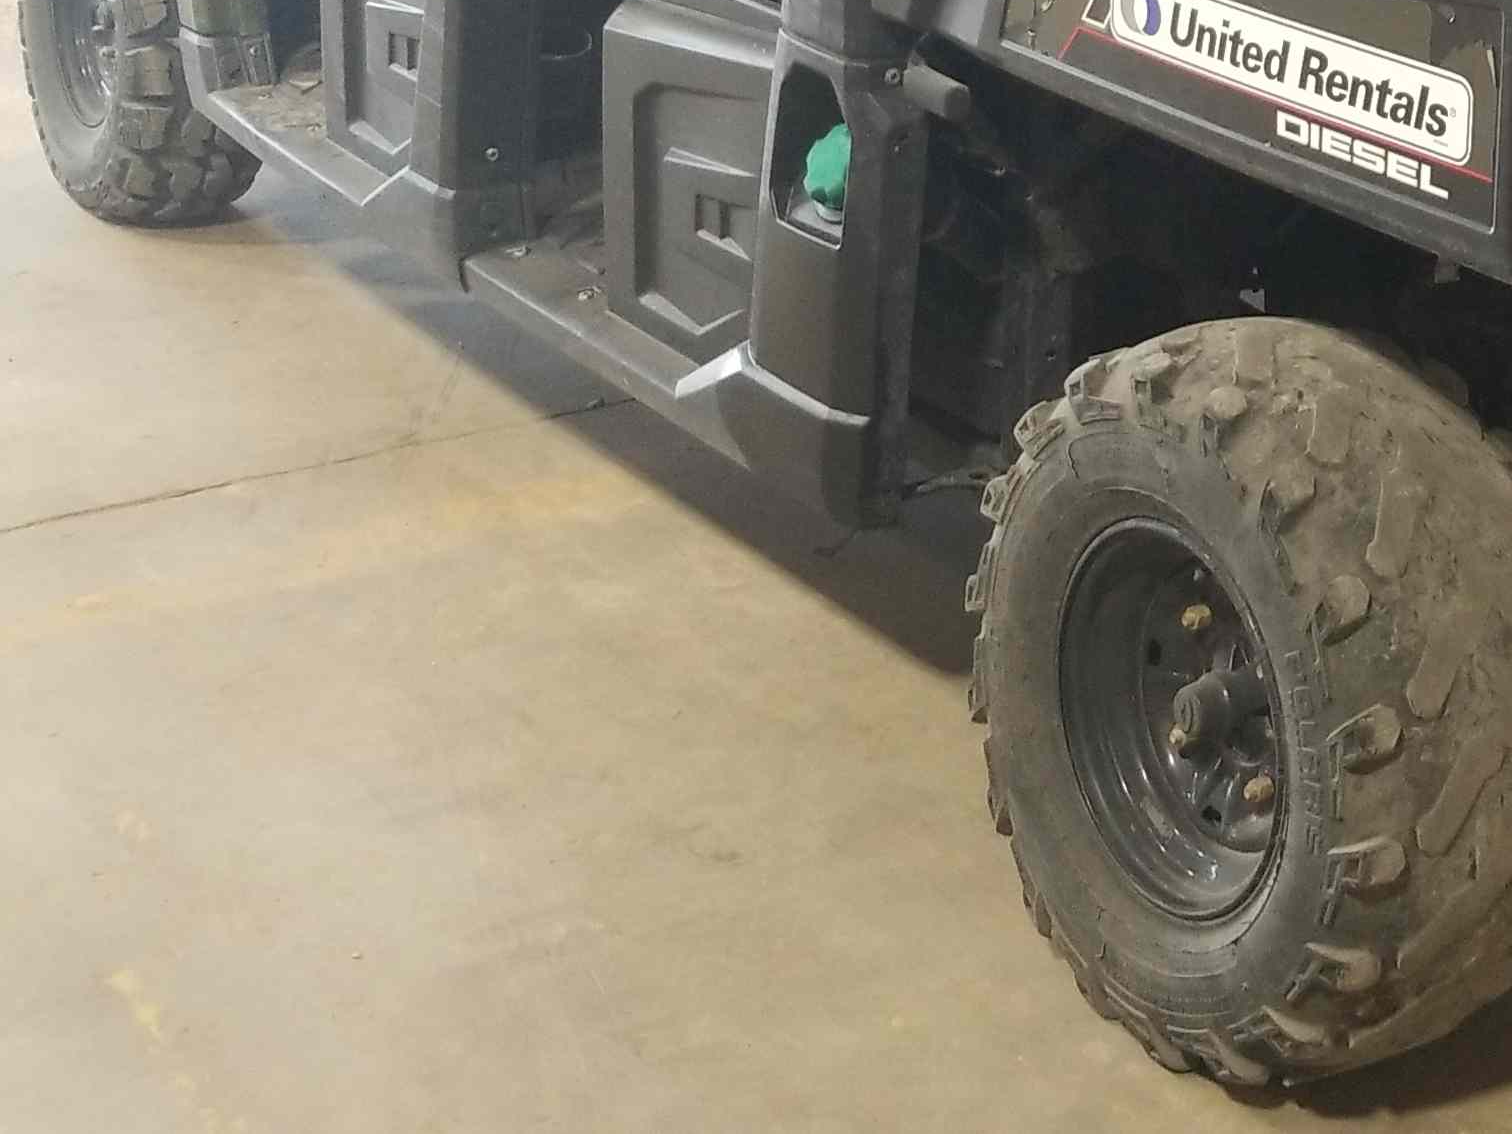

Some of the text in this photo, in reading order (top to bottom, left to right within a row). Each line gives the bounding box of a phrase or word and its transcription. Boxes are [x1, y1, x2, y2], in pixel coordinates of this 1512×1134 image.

[1169, 1, 1450, 137] United Rentals
[1275, 109, 1449, 200] DIESEL
